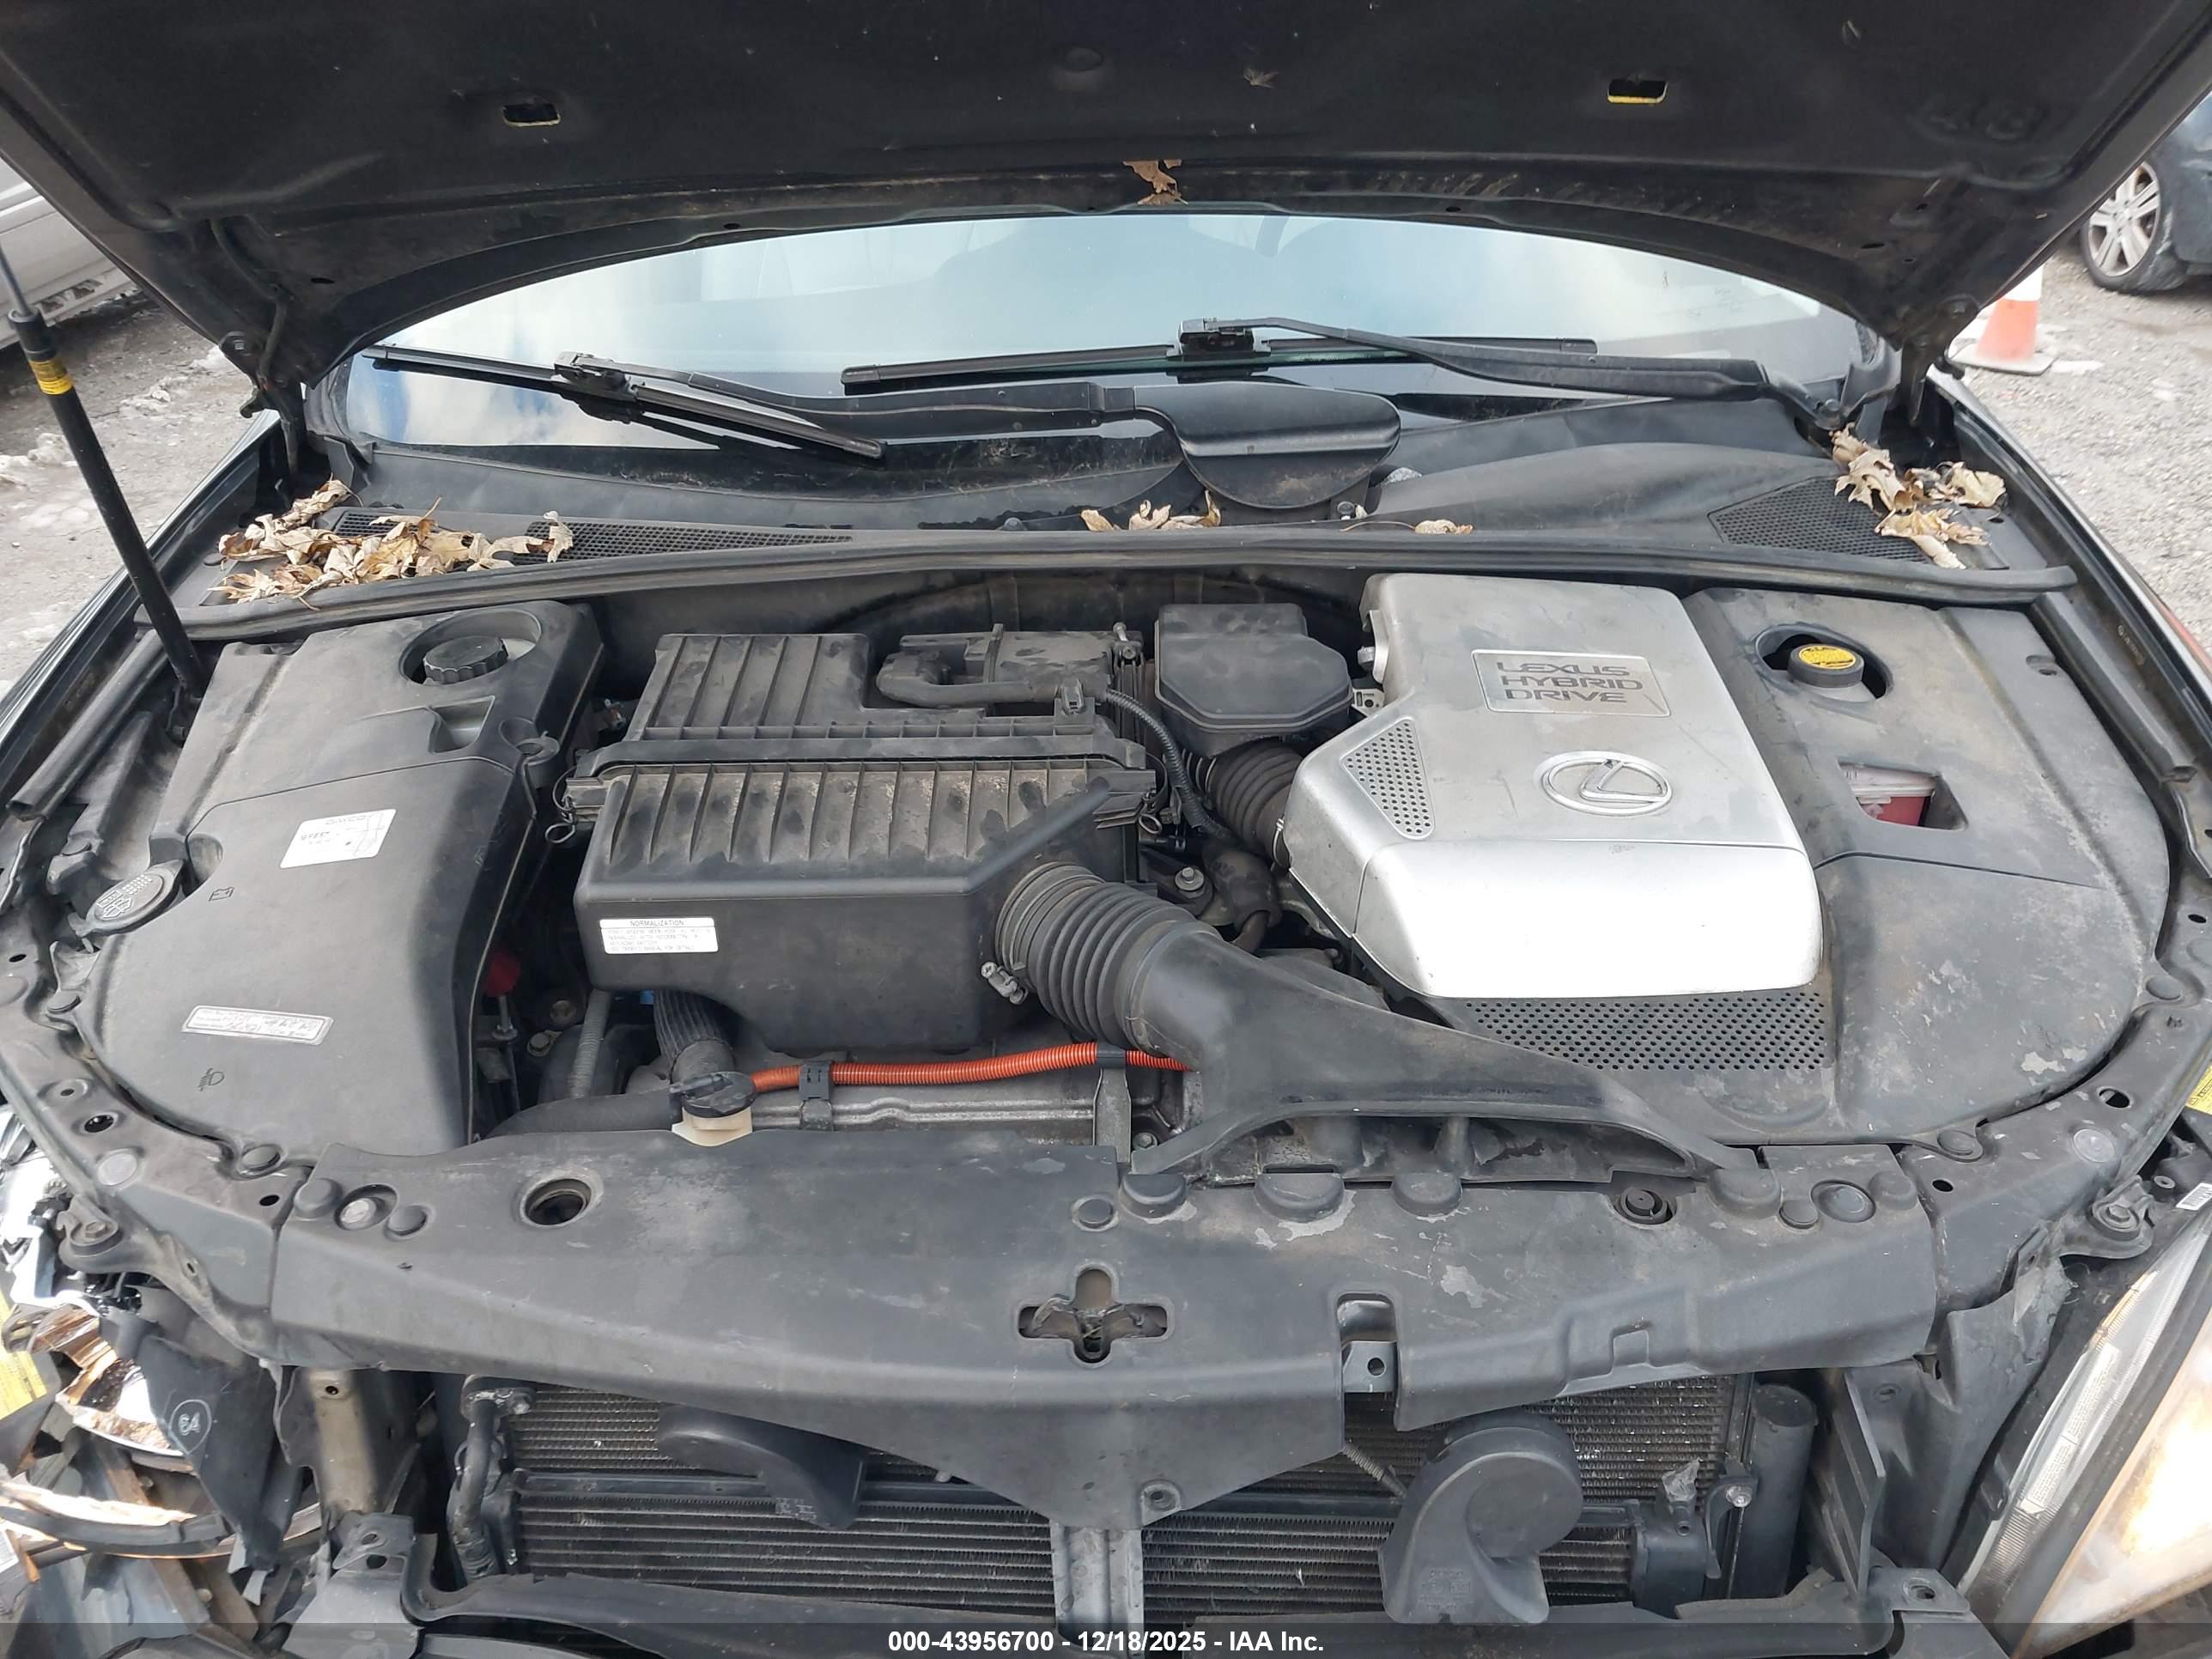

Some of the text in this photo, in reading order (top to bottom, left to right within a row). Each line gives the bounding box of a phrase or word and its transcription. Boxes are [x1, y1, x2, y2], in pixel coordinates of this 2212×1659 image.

[1497, 662, 1630, 676] LEXUS
[1501, 676, 1643, 690] HYBRID
[1505, 690, 1627, 702] DRIVE
